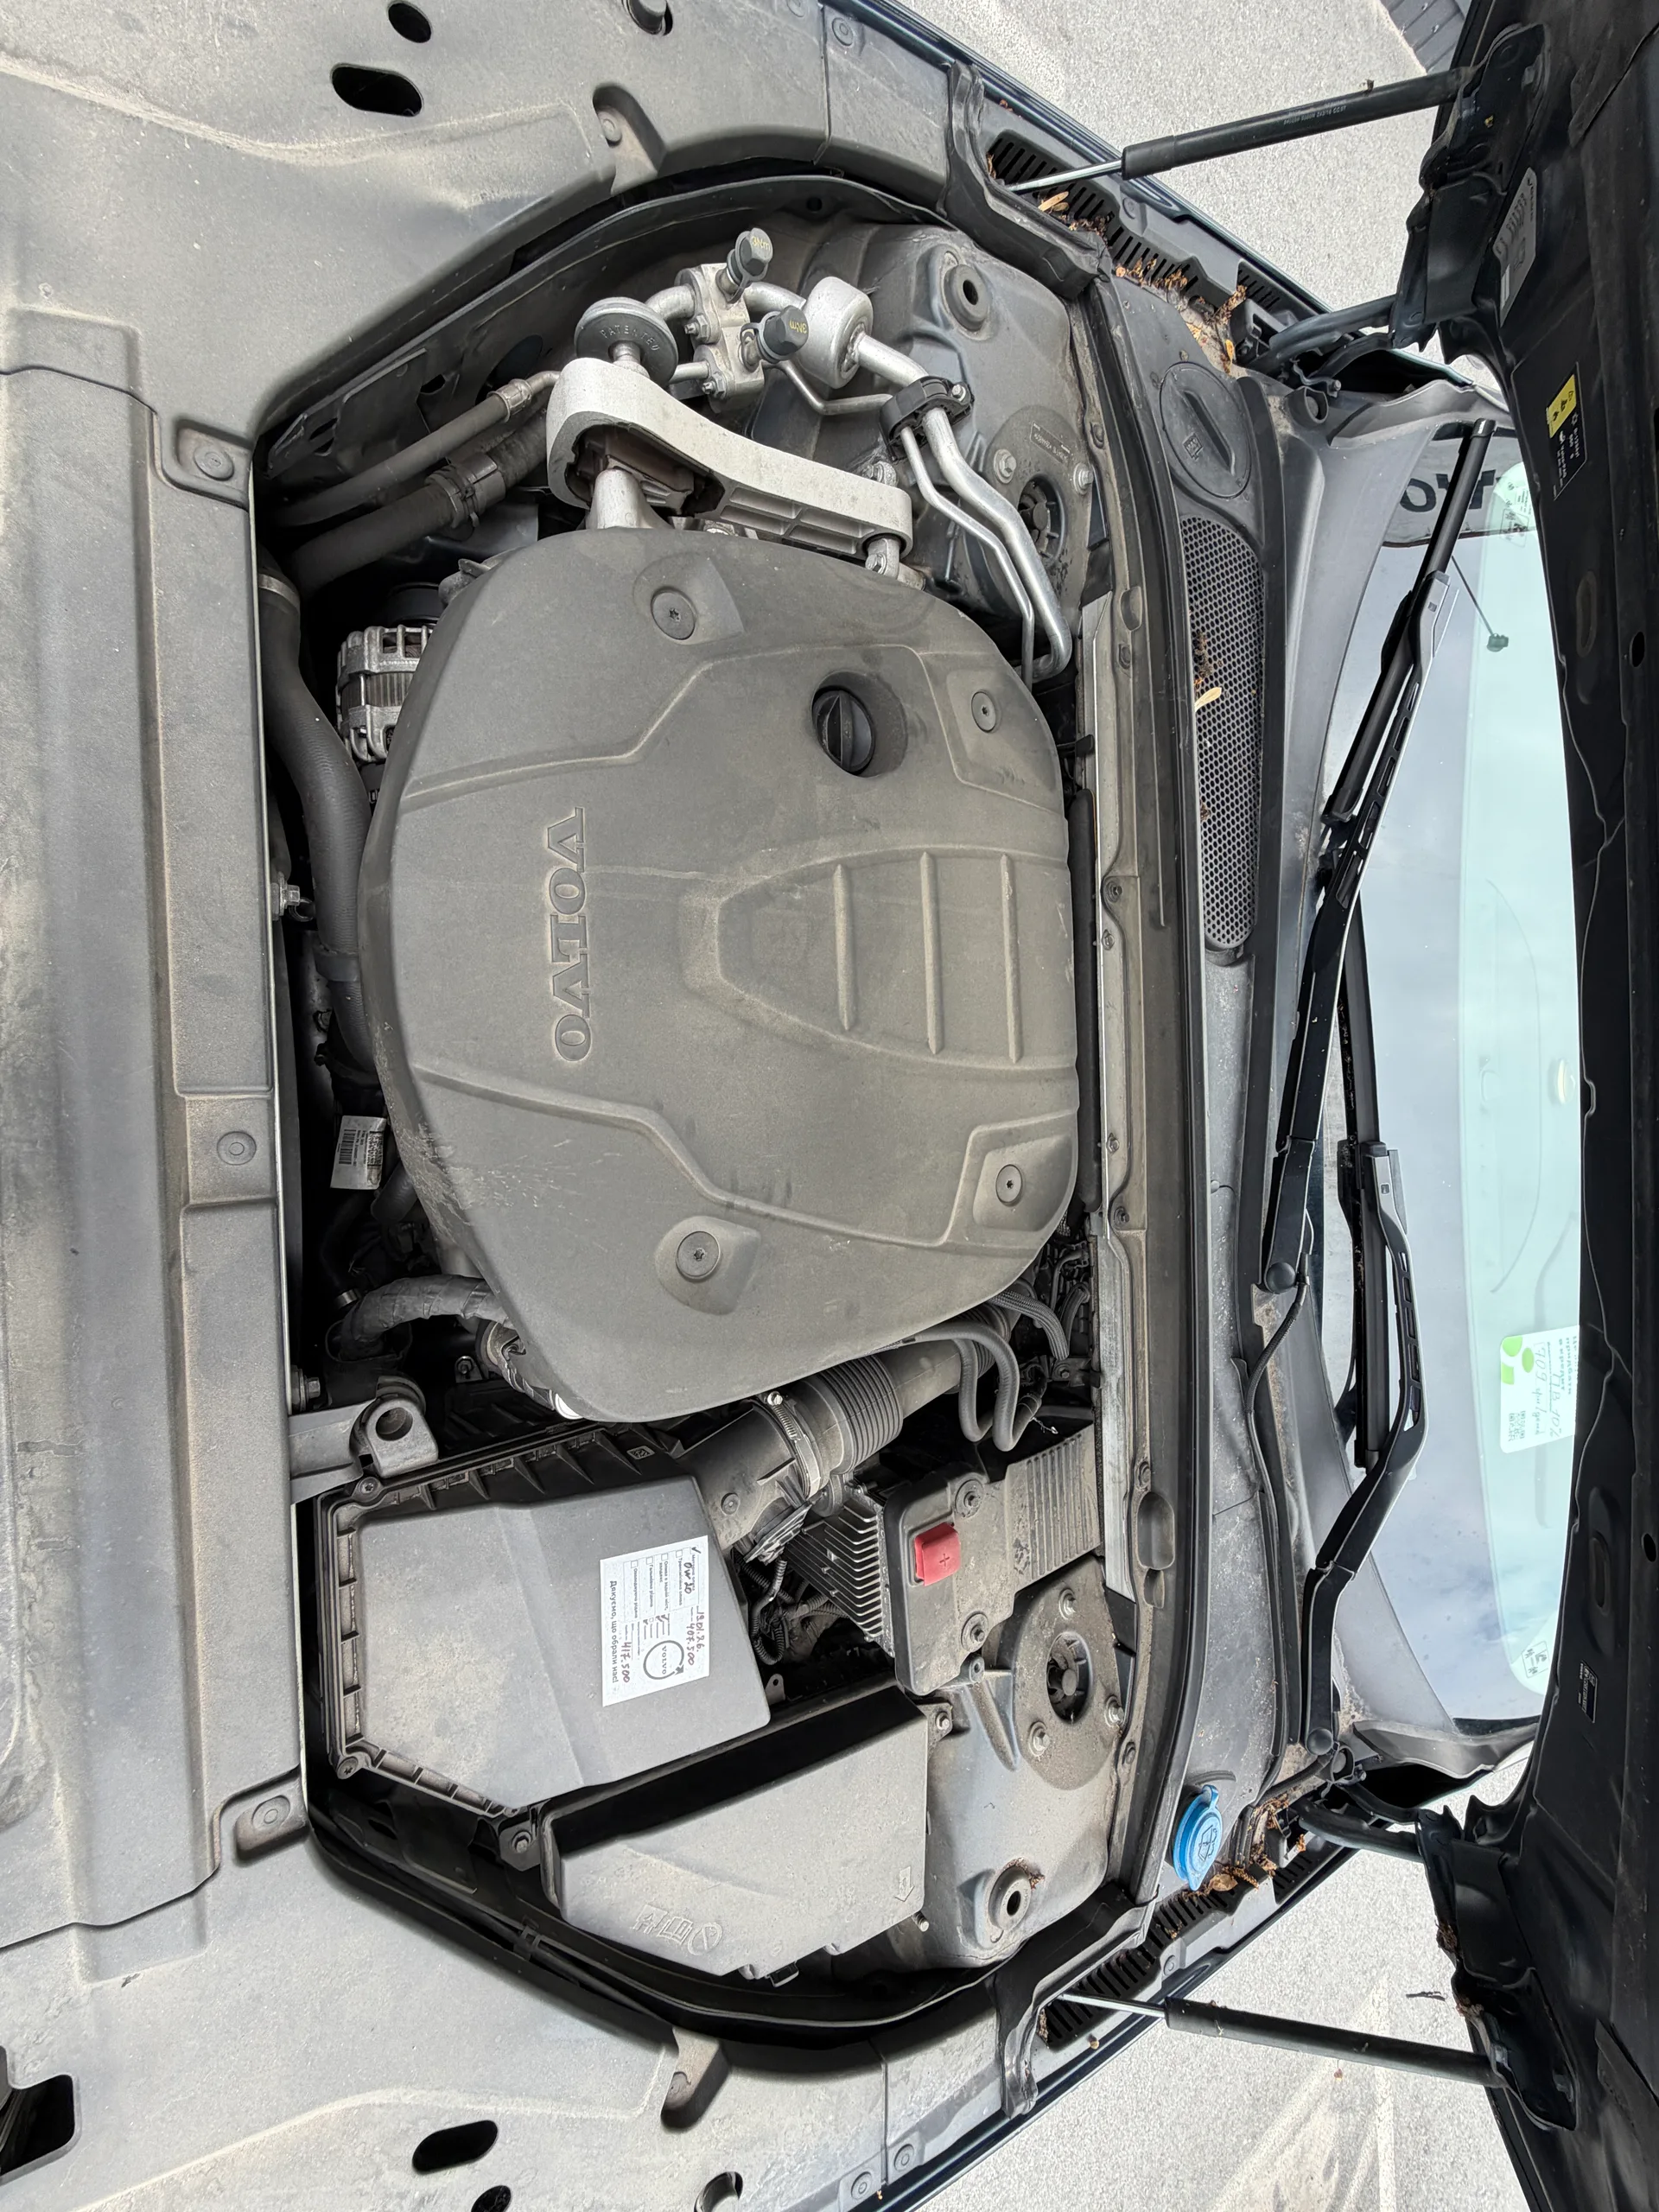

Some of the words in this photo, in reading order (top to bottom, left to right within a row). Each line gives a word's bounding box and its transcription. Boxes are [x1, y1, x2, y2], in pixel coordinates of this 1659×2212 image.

[790, 321, 807, 334] 3Nm
[547, 806, 593, 1063] VOLVO
[610, 1621, 617, 1633] що
[610, 1635, 619, 1665] обрали
